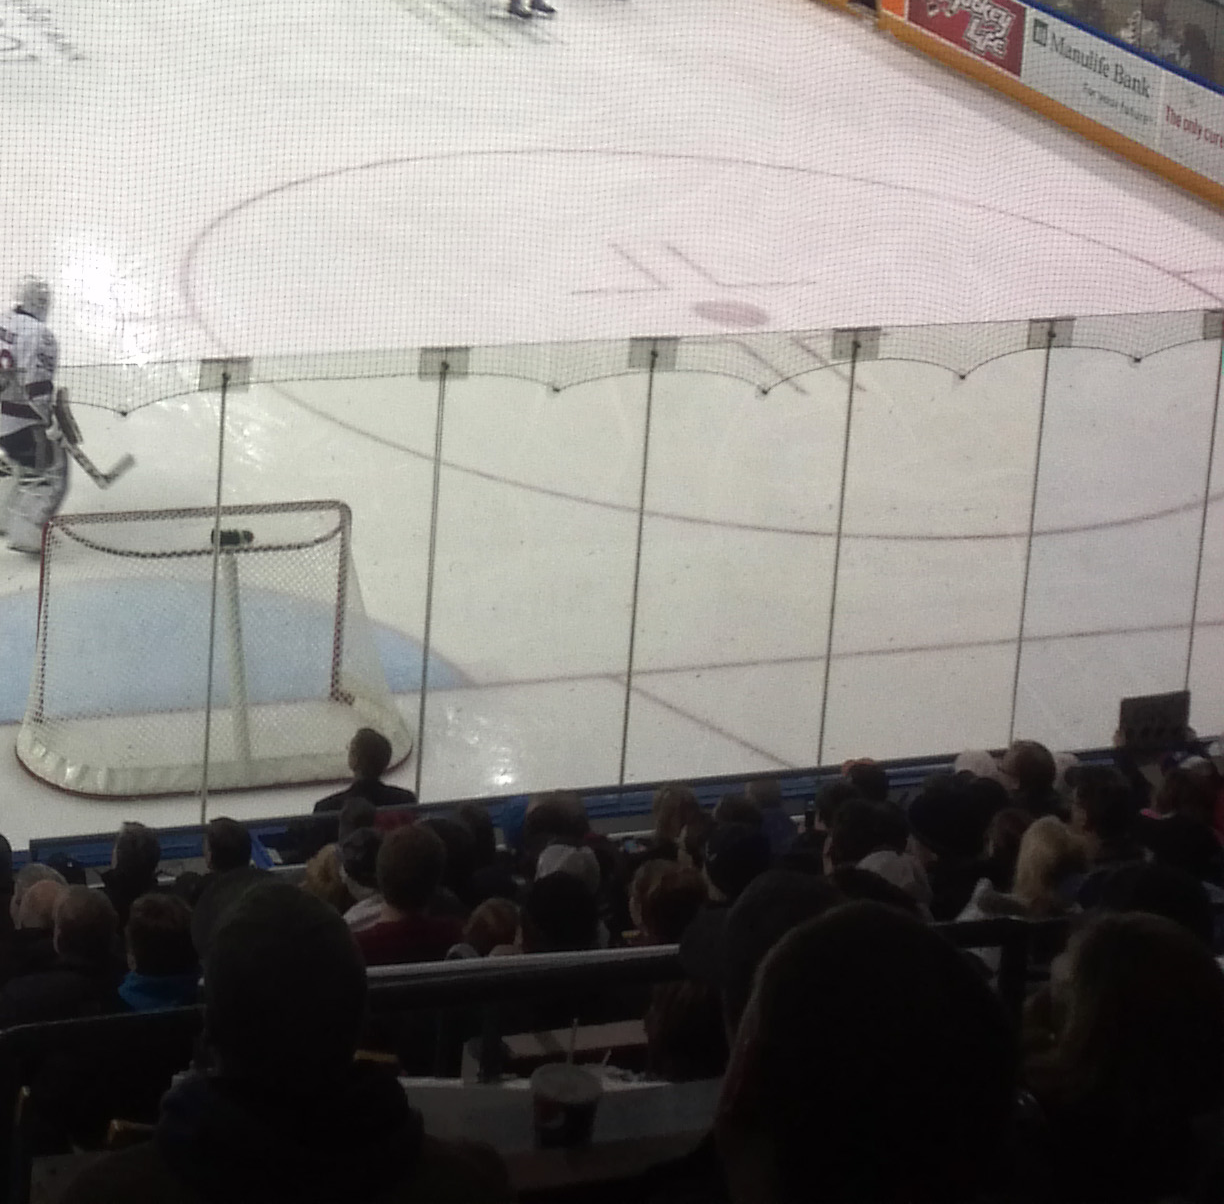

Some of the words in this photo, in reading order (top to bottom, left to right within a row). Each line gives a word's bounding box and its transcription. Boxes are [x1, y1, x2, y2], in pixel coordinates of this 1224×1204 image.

[1050, 31, 1111, 78] Manulife
[1113, 63, 1151, 98] Bank
[1165, 104, 1181, 129] The
[1183, 117, 1203, 141] only
